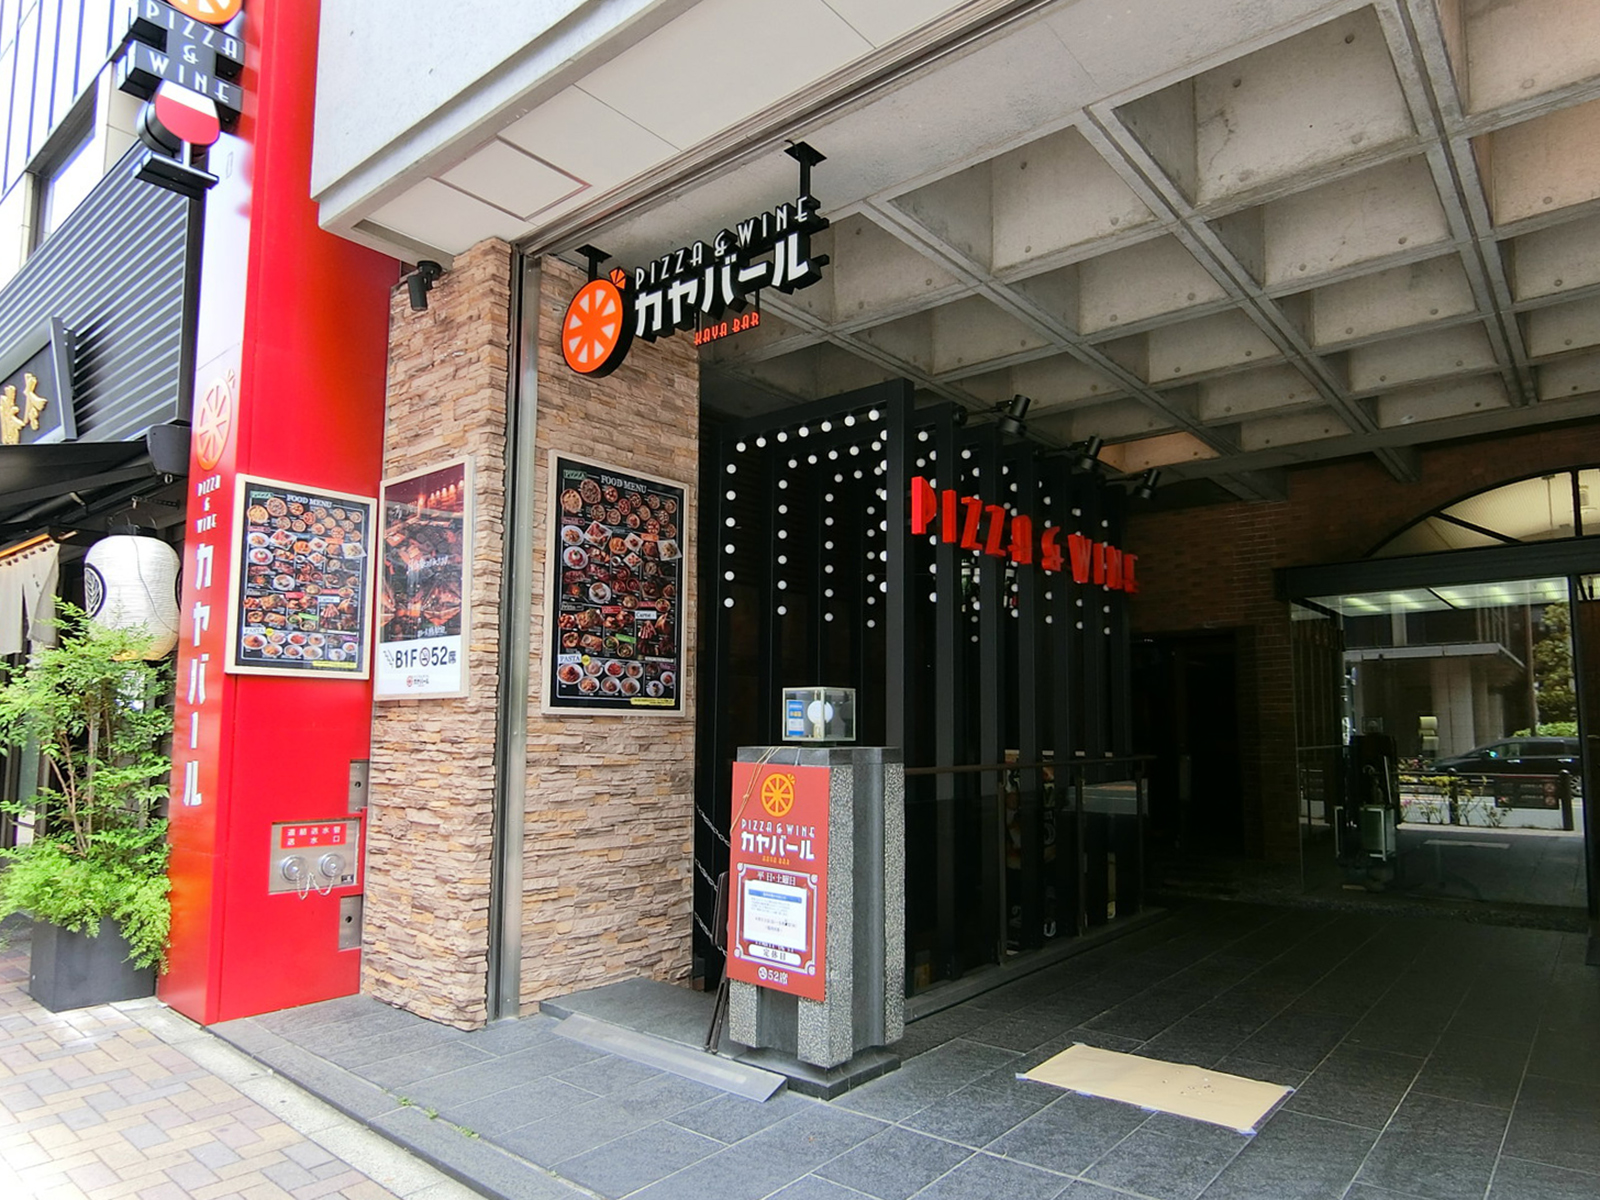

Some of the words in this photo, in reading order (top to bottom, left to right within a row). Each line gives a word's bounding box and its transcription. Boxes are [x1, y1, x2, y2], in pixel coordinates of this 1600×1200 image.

[145, 2, 238, 59] PIZZA
[183, 45, 198, 64] &
[149, 51, 231, 104] WINE
[635, 241, 703, 290] PIZZA
[714, 229, 729, 257] &
[737, 196, 808, 245] WINE
[635, 232, 809, 337] カヤバール
[694, 325, 728, 346] KAYA
[732, 311, 760, 333] BAR
[286, 494, 308, 504] FOOD
[309, 498, 333, 508] MENU
[601, 475, 623, 488] FOOD
[624, 481, 647, 494] MENU
[911, 476, 1032, 565] PIZZA
[1041, 526, 1064, 572] &
[1067, 533, 1139, 594] WINE
[183, 542, 213, 806] カヤバール
[395, 648, 418, 668] B1F
[740, 831, 815, 860] カヤバール
[741, 818, 773, 832] PIZZA
[776, 822, 783, 834] &
[786, 824, 815, 838] WINE
